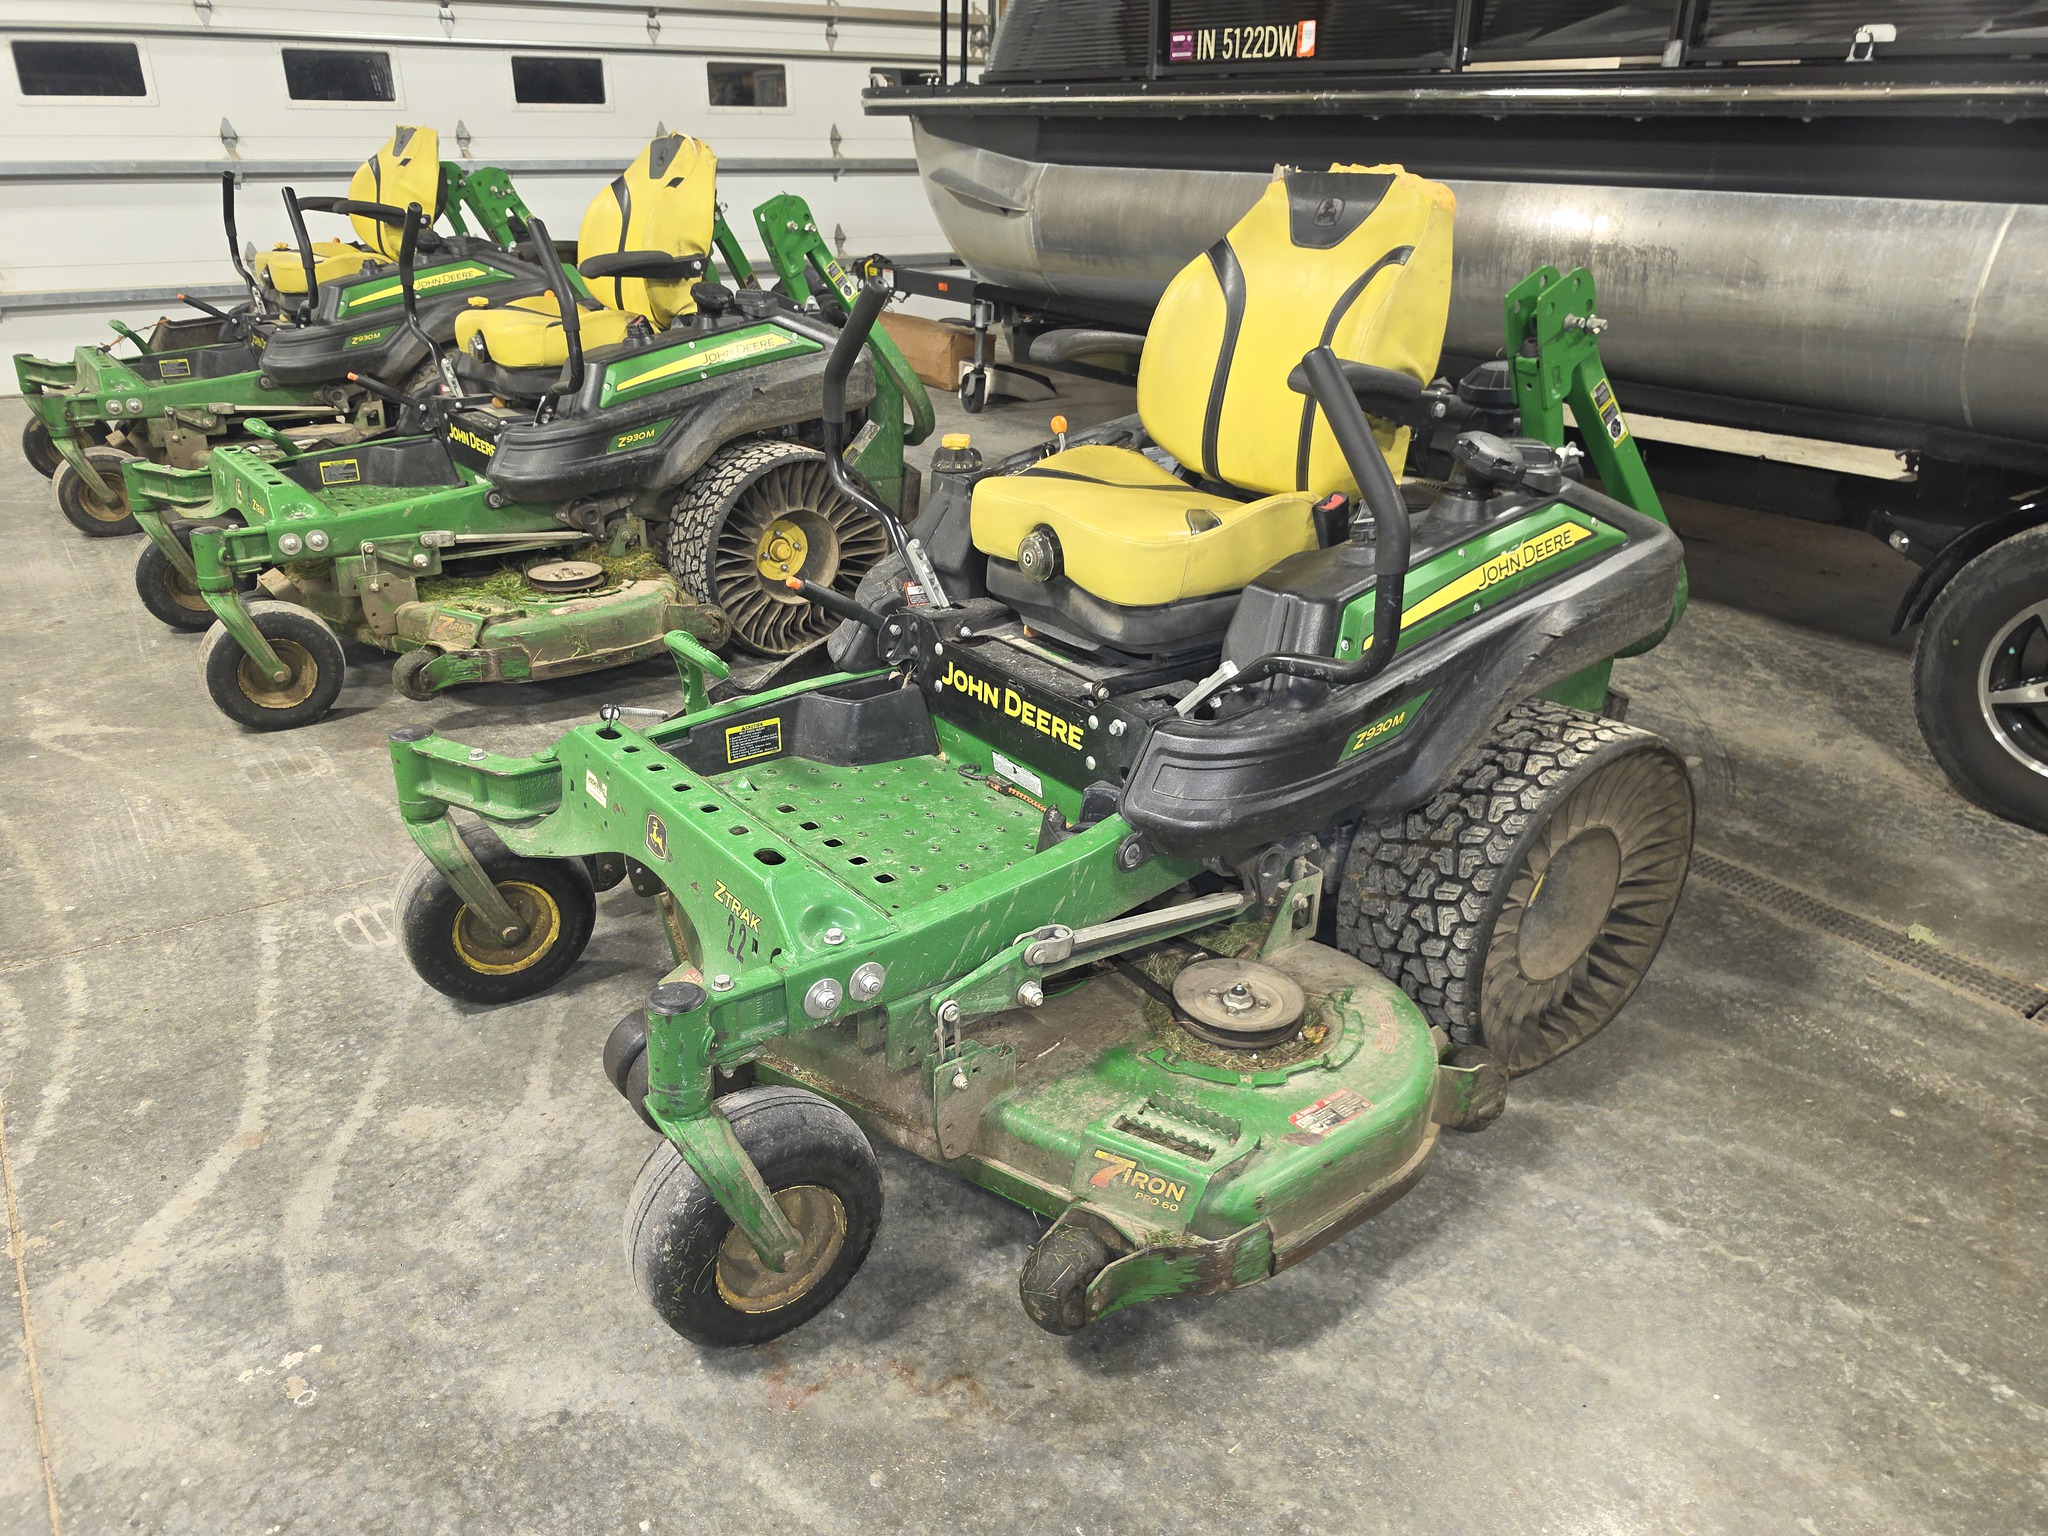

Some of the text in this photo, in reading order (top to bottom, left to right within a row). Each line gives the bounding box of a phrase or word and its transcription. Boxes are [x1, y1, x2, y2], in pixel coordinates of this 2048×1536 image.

[1197, 29, 1216, 60] IN
[1222, 24, 1298, 60] 5122DW
[416, 270, 474, 290] JOHN DEERE
[702, 338, 775, 365] JOHN DEERE
[449, 422, 470, 446] JOHN
[617, 429, 655, 448] Z930M
[1478, 529, 1573, 588] JOHN DEERE
[941, 661, 1085, 751] JOHN DEERE
[1353, 711, 1406, 751] Z930M
[713, 879, 762, 935] ZTRAK
[726, 913, 747, 964] 22
[1134, 1191, 1179, 1212] PRO 60
